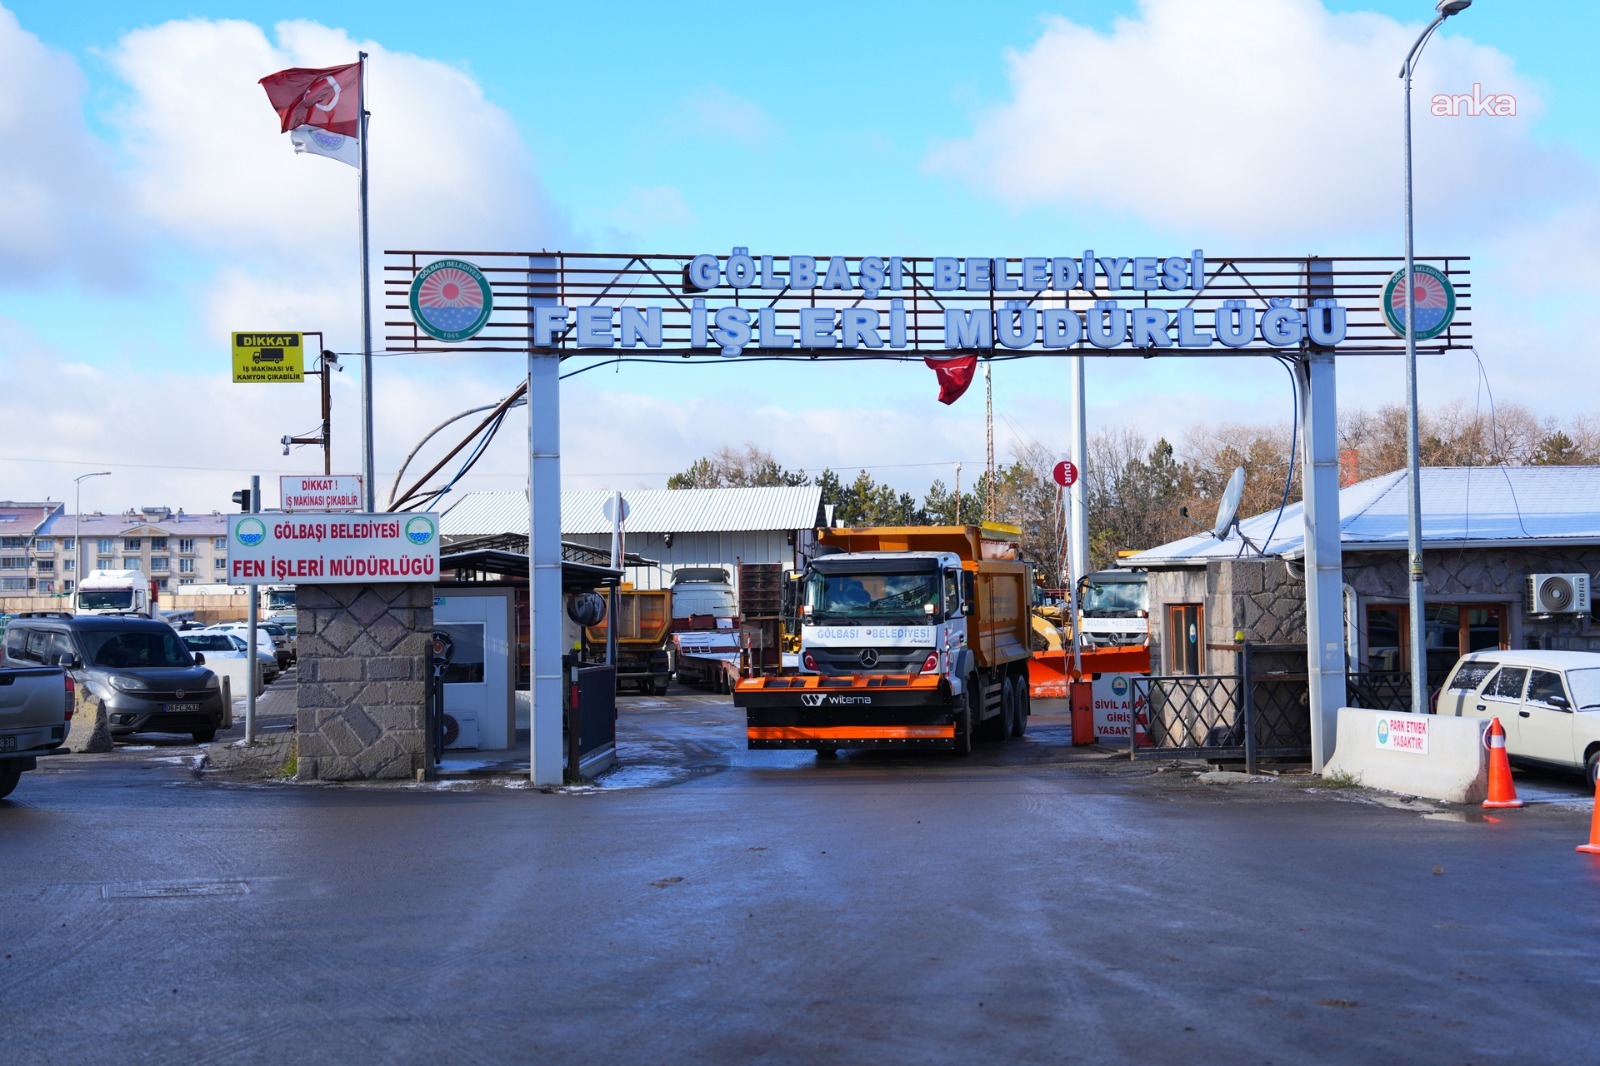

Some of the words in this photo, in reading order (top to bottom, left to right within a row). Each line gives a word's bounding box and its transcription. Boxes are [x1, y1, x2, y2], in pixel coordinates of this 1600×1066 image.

[420, 261, 445, 280] GÖLBAŞI
[446, 261, 482, 281] BELEDİYESİ
[690, 247, 902, 299] GÖLBAŞI
[933, 249, 1205, 291] BELEDİYESİ
[533, 305, 663, 348] FEN
[690, 297, 908, 358] İŞLERİ
[944, 297, 1348, 348] MÜDÜRLÜĞÜ
[243, 335, 292, 346] DİKKAT
[302, 478, 333, 490] DİKKAT
[286, 494, 292, 508] İŞ
[294, 493, 325, 506] MAKİNASI
[326, 492, 358, 508] ÇIKABİLİR
[274, 521, 327, 543] GÖLBAŞI
[331, 520, 400, 539] BELEDİYESİ
[233, 559, 265, 577] FEN
[271, 555, 324, 581] İŞLERİ
[817, 627, 859, 639] GÖLBAŞI
[872, 627, 930, 639] BELEDİYESİ
[828, 694, 872, 704] witerna
[1095, 699, 1119, 710] SİVİL
[1390, 719, 1405, 732] PARK
[1406, 721, 1426, 735] ETMEK
